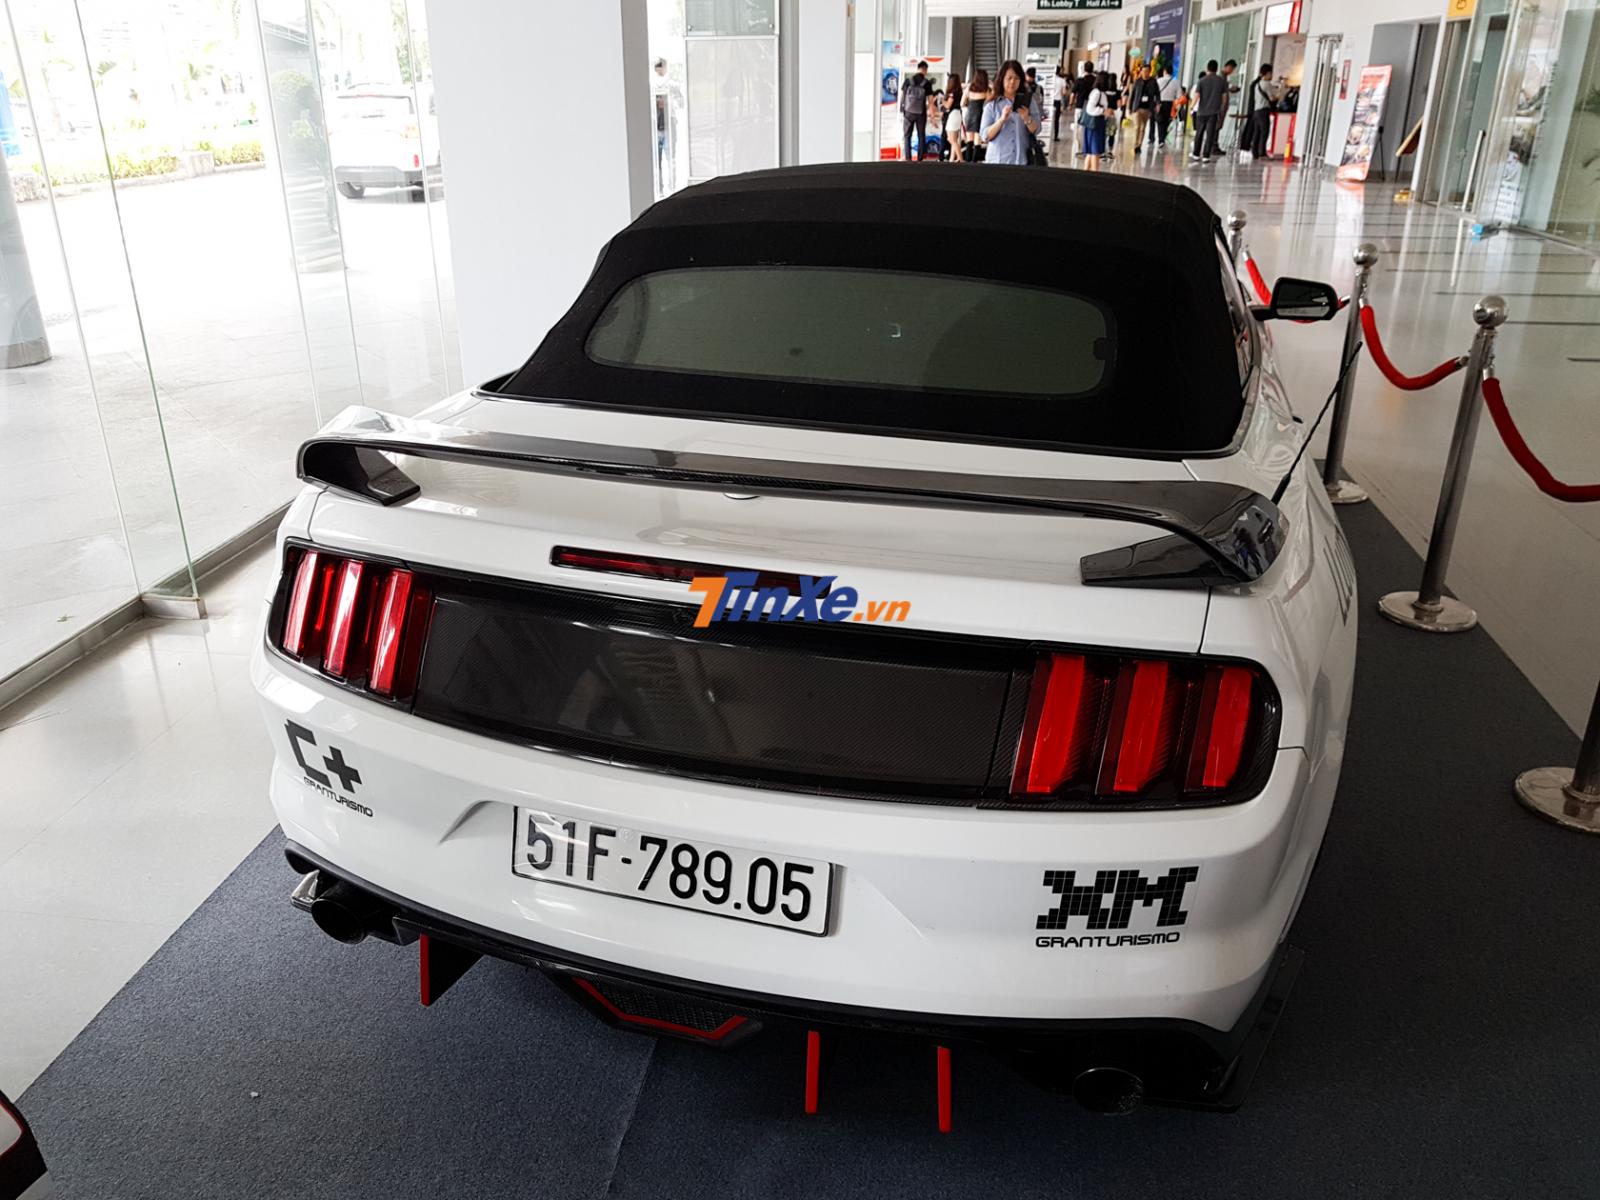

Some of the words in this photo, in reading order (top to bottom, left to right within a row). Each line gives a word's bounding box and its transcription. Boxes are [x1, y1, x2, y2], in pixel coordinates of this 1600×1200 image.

[1052, 0, 1073, 9] Lobby
[304, 776, 374, 817] GRANTURISMO
[526, 814, 814, 922] 51F-789.05
[1036, 932, 1180, 948] GRANTURISMO
